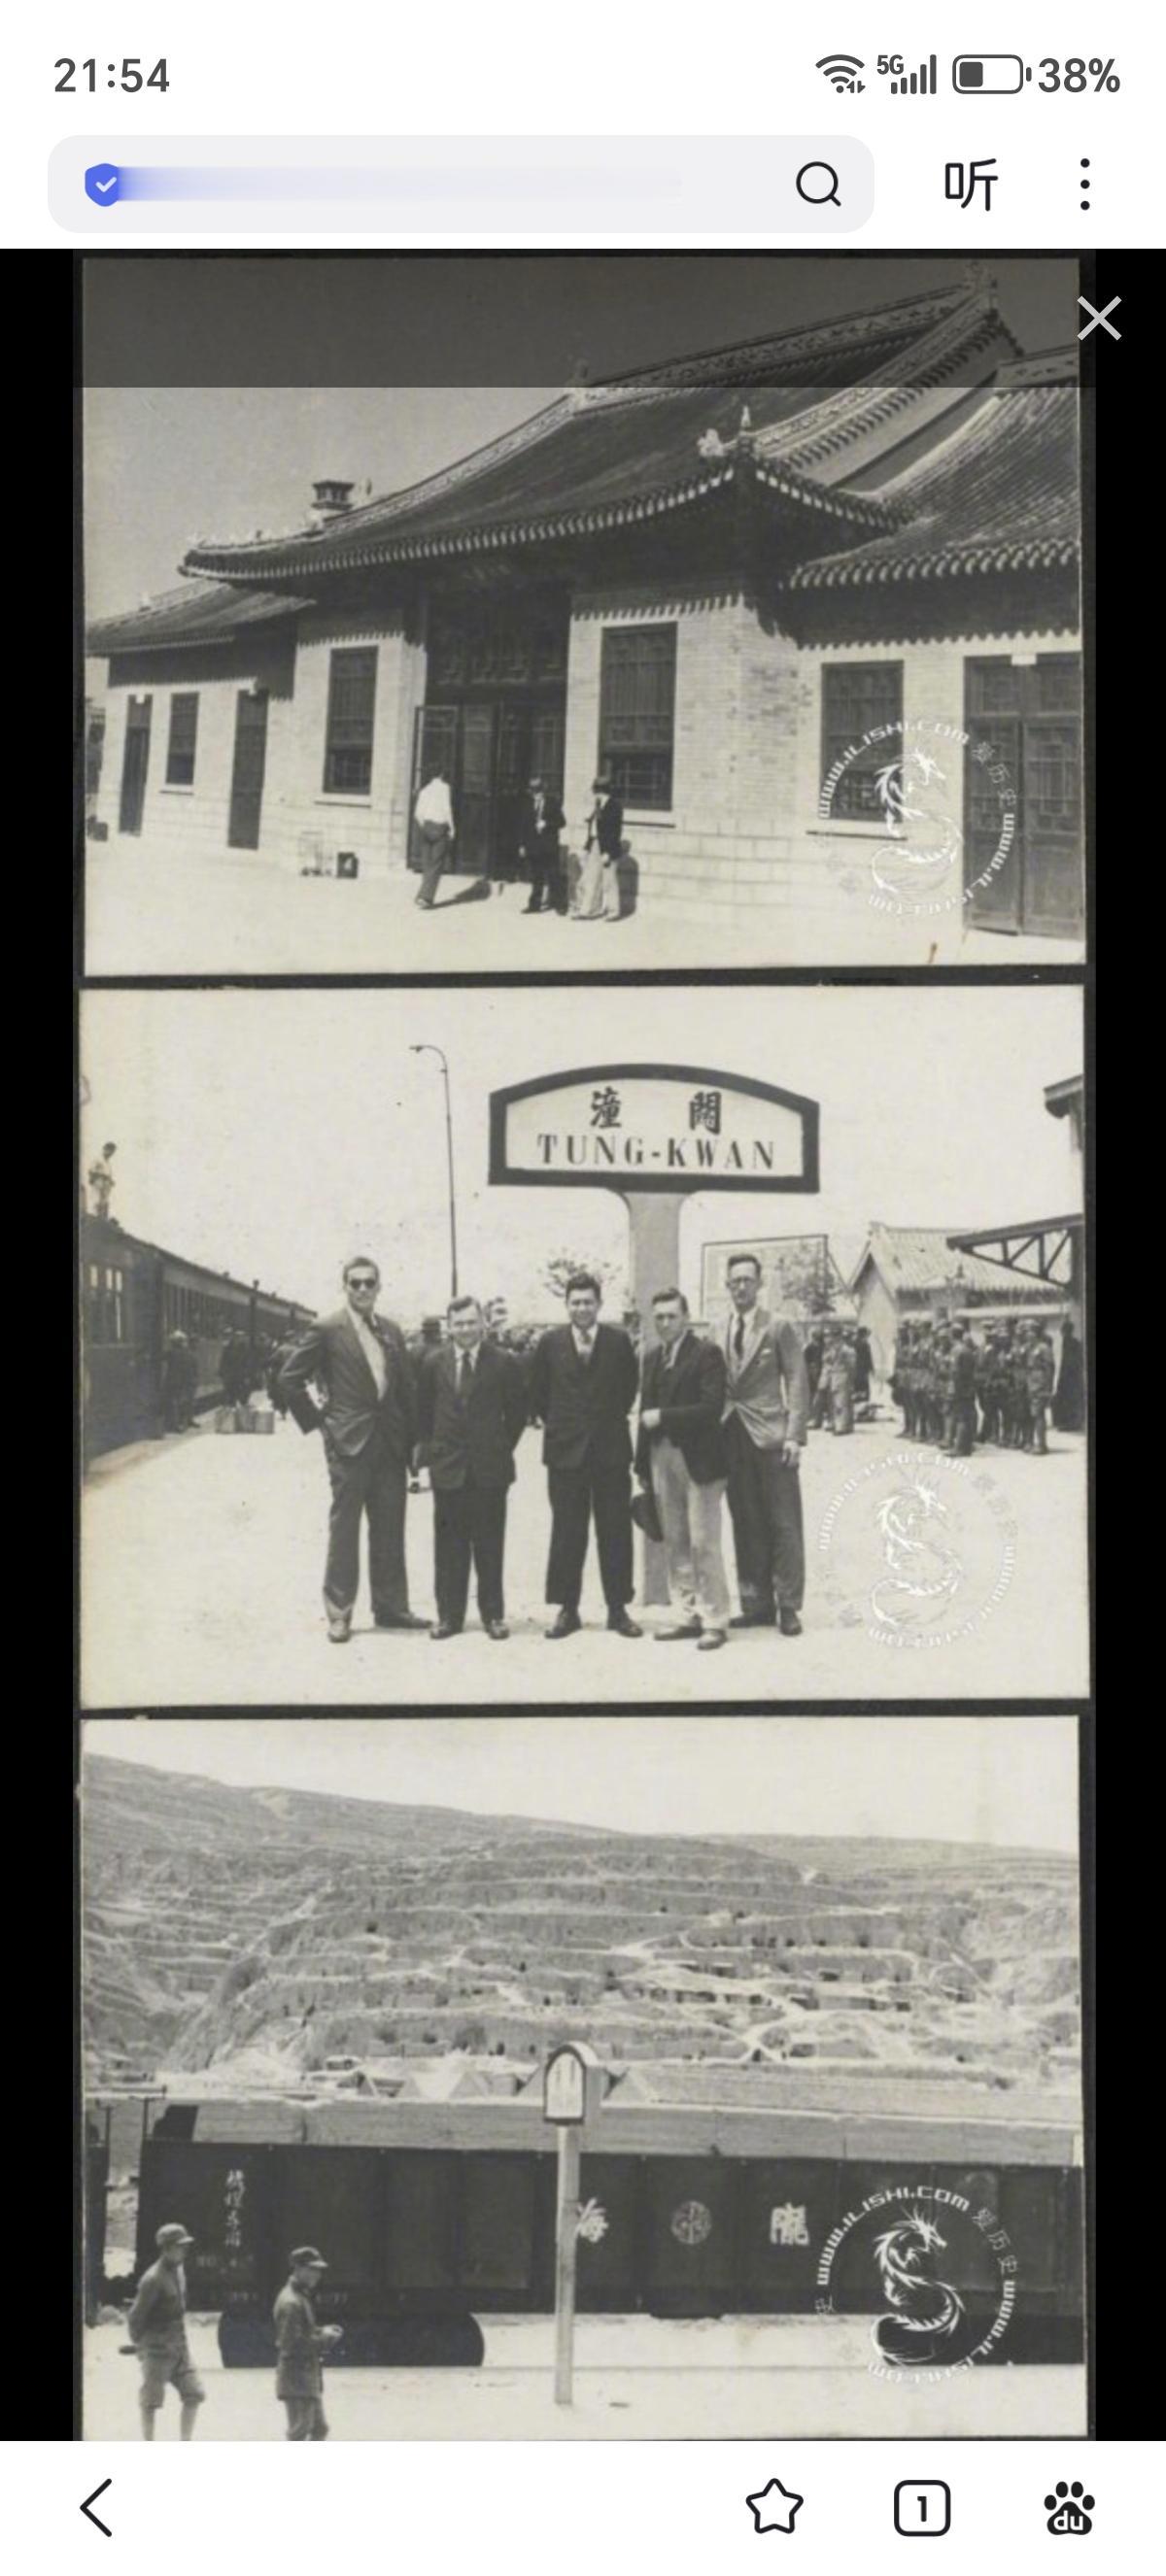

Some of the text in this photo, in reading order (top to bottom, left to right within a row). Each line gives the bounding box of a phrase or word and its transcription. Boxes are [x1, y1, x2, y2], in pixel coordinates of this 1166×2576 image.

[54, 58, 169, 92] 21:54
[876, 54, 905, 76] 5G
[1039, 58, 1120, 92] 38%
[944, 158, 999, 212] 听
[536, 1133, 775, 1170] TUNG-KWAN
[916, 2495, 928, 2523] 1
[1052, 2510, 1084, 2531] du
